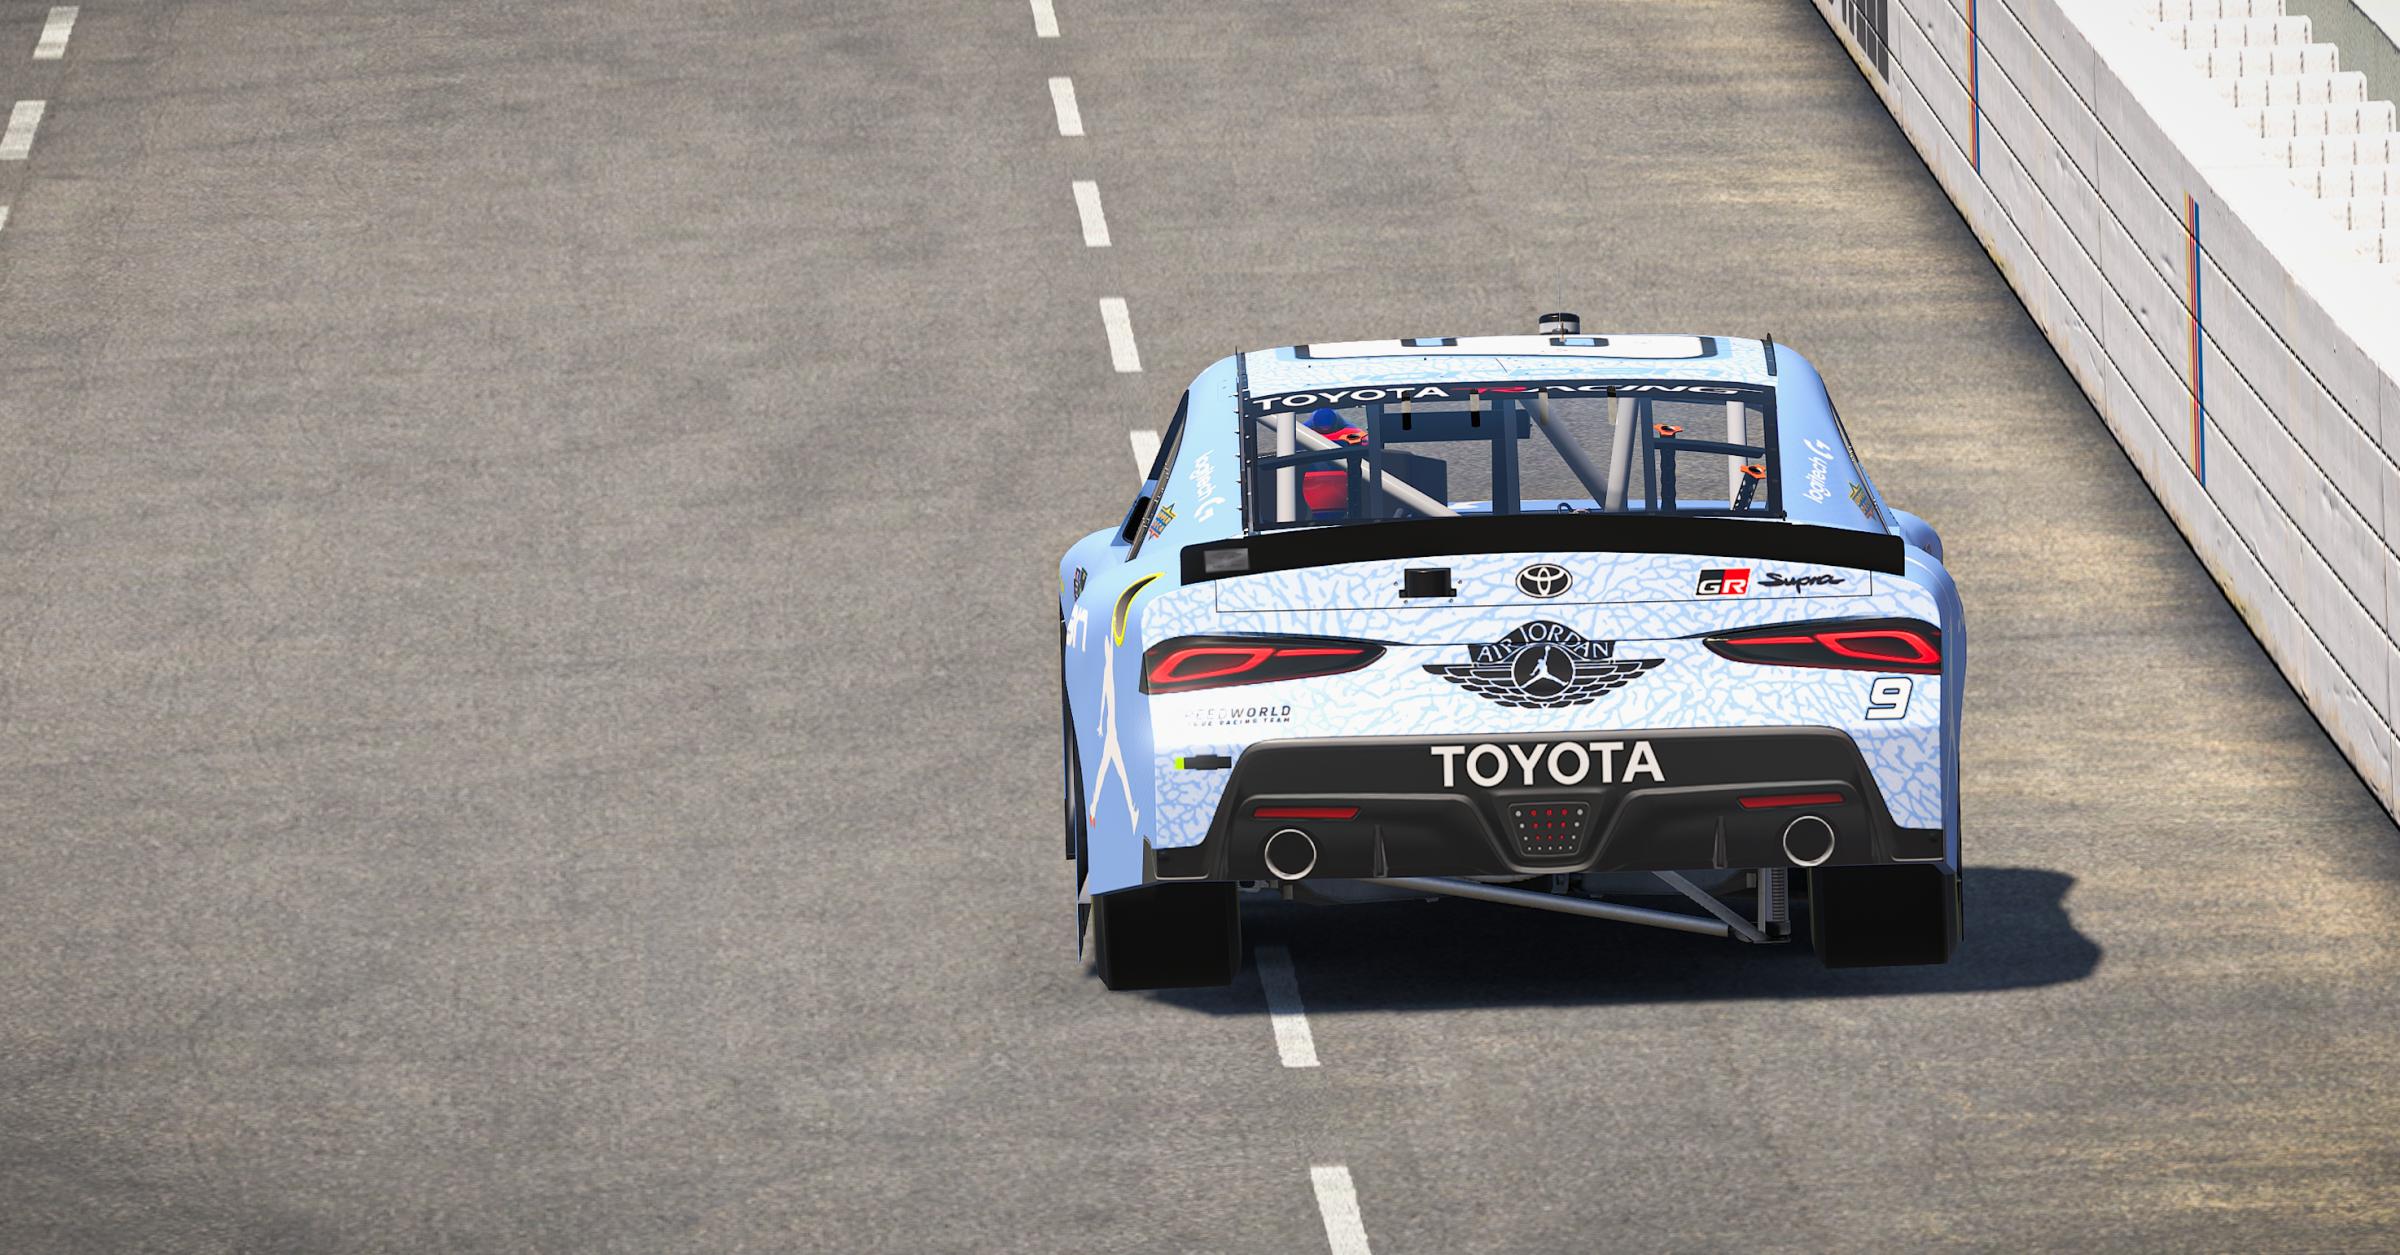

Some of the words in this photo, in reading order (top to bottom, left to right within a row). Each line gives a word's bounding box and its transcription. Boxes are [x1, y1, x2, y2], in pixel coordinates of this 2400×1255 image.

[1253, 386, 1450, 411] TOYOTA
[1452, 383, 1763, 395] RACING
[1698, 579, 1748, 595] GR
[1757, 572, 1846, 594] Supra
[1477, 637, 1515, 662] AIR
[1519, 622, 1609, 659] JORDAN
[1864, 676, 1914, 720] 9
[1431, 740, 1666, 788] TOYOTA
